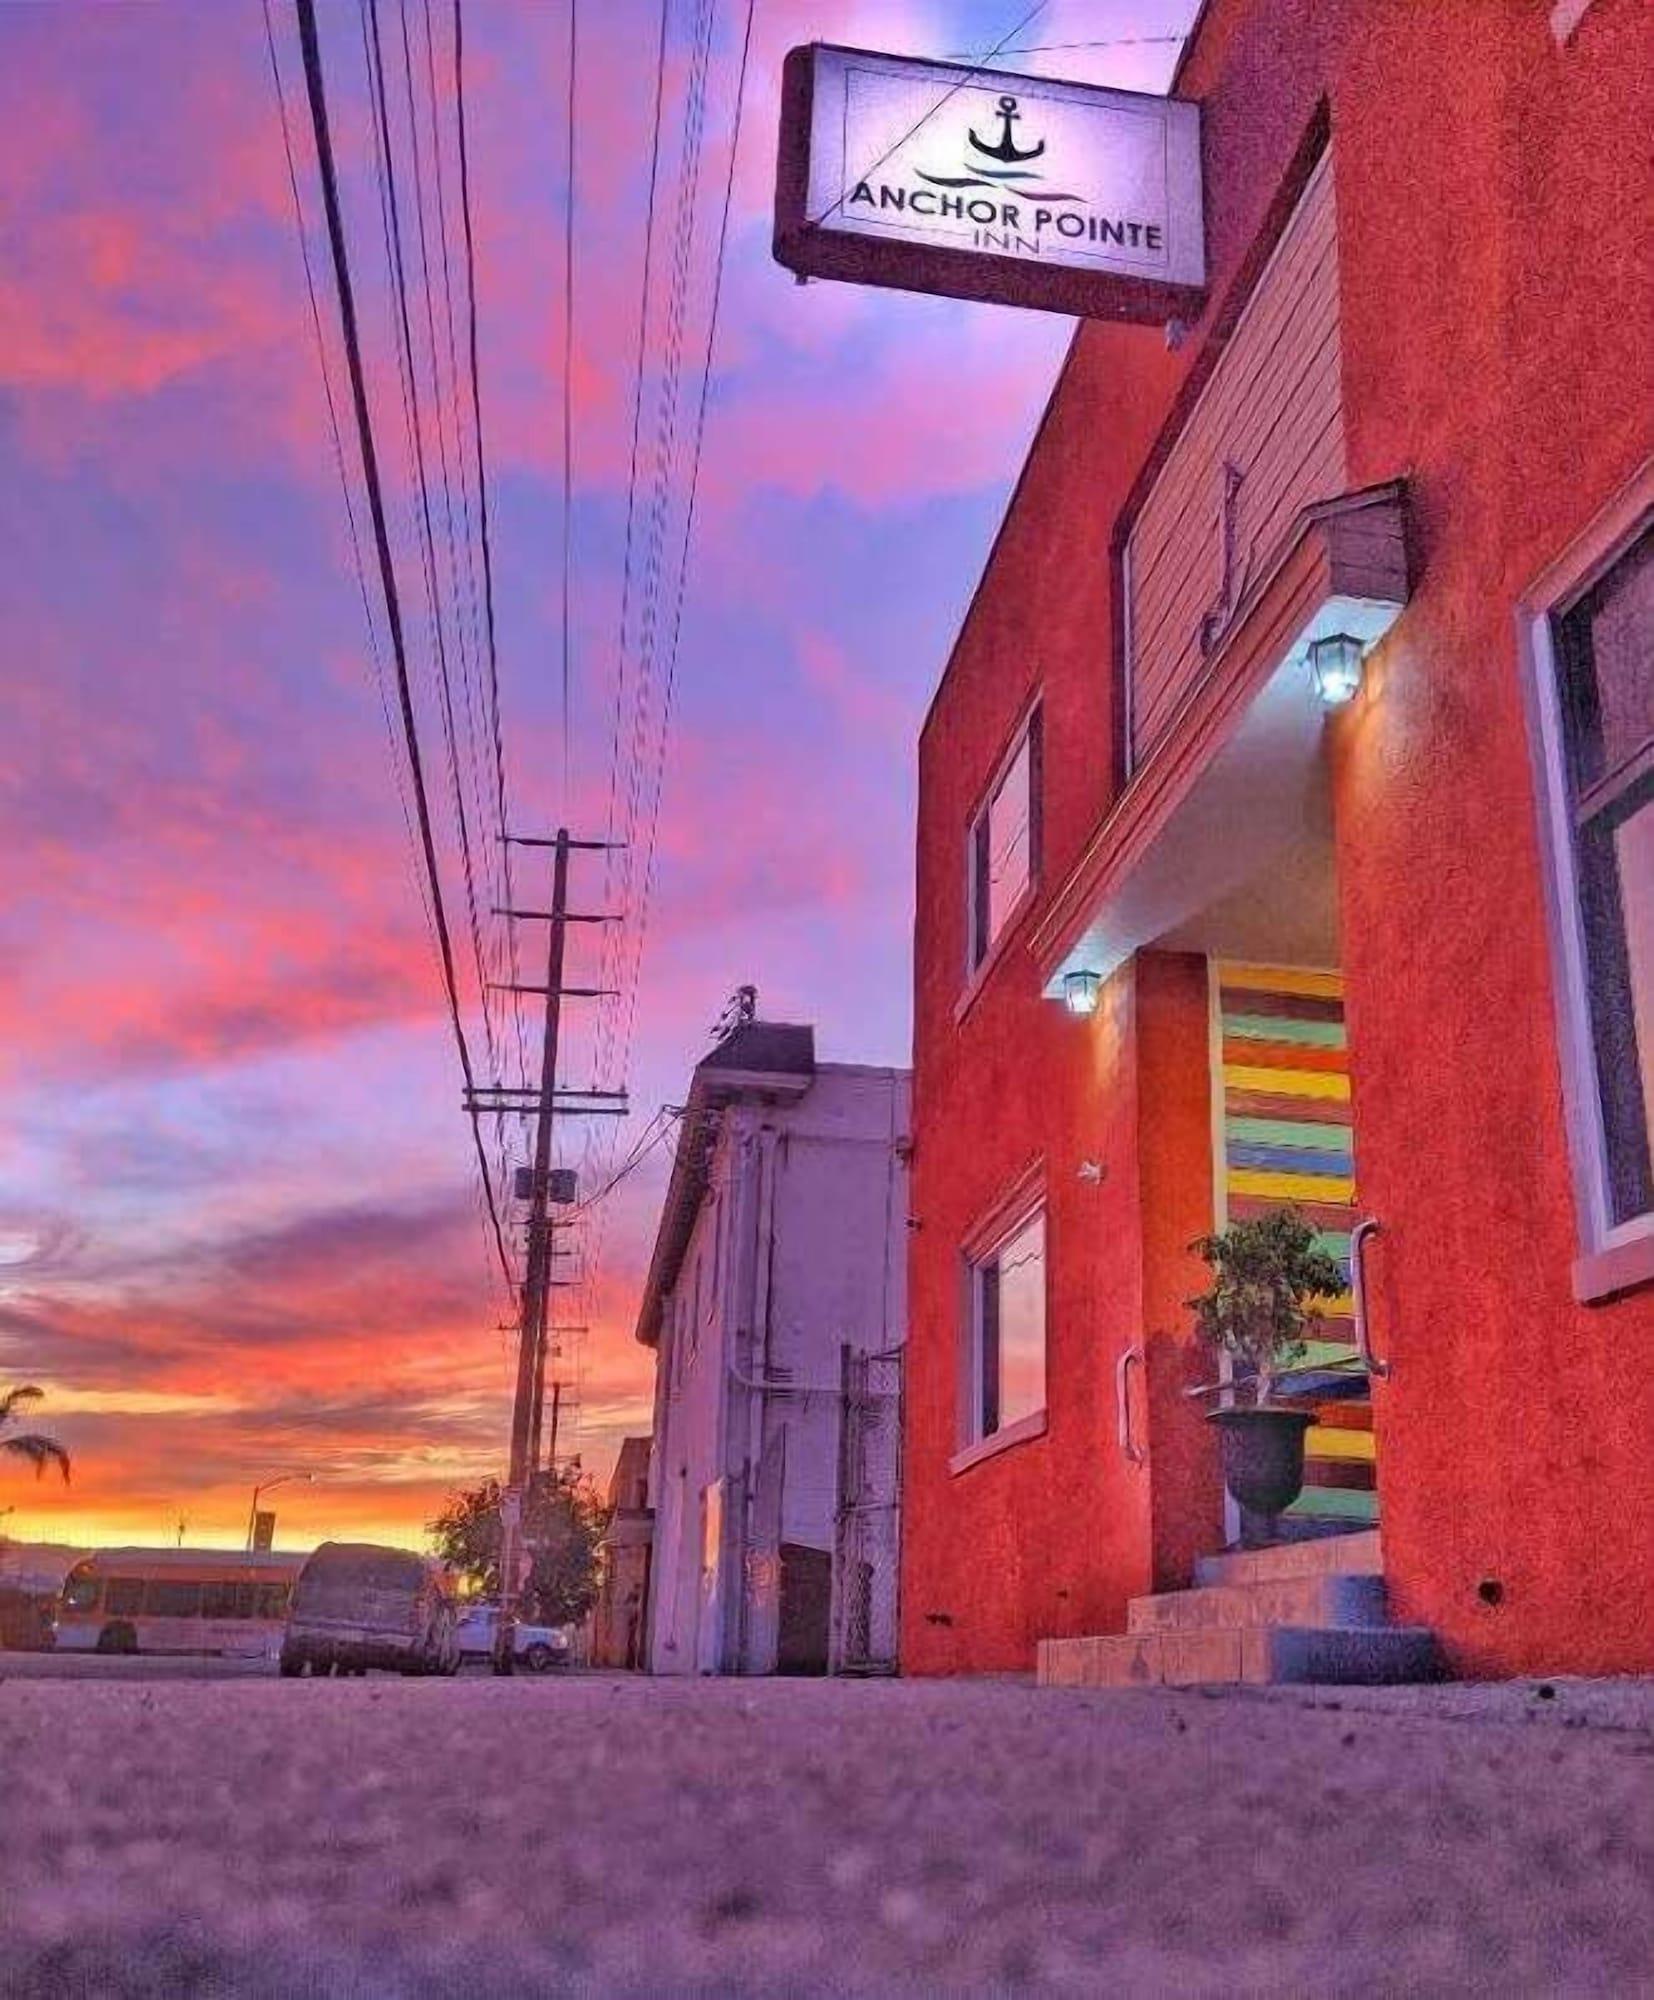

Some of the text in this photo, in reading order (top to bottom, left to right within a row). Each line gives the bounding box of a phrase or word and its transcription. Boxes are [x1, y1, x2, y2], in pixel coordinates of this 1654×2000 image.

[850, 182, 1163, 249] ANCHOR POINTE
[973, 229, 1040, 254] INN
